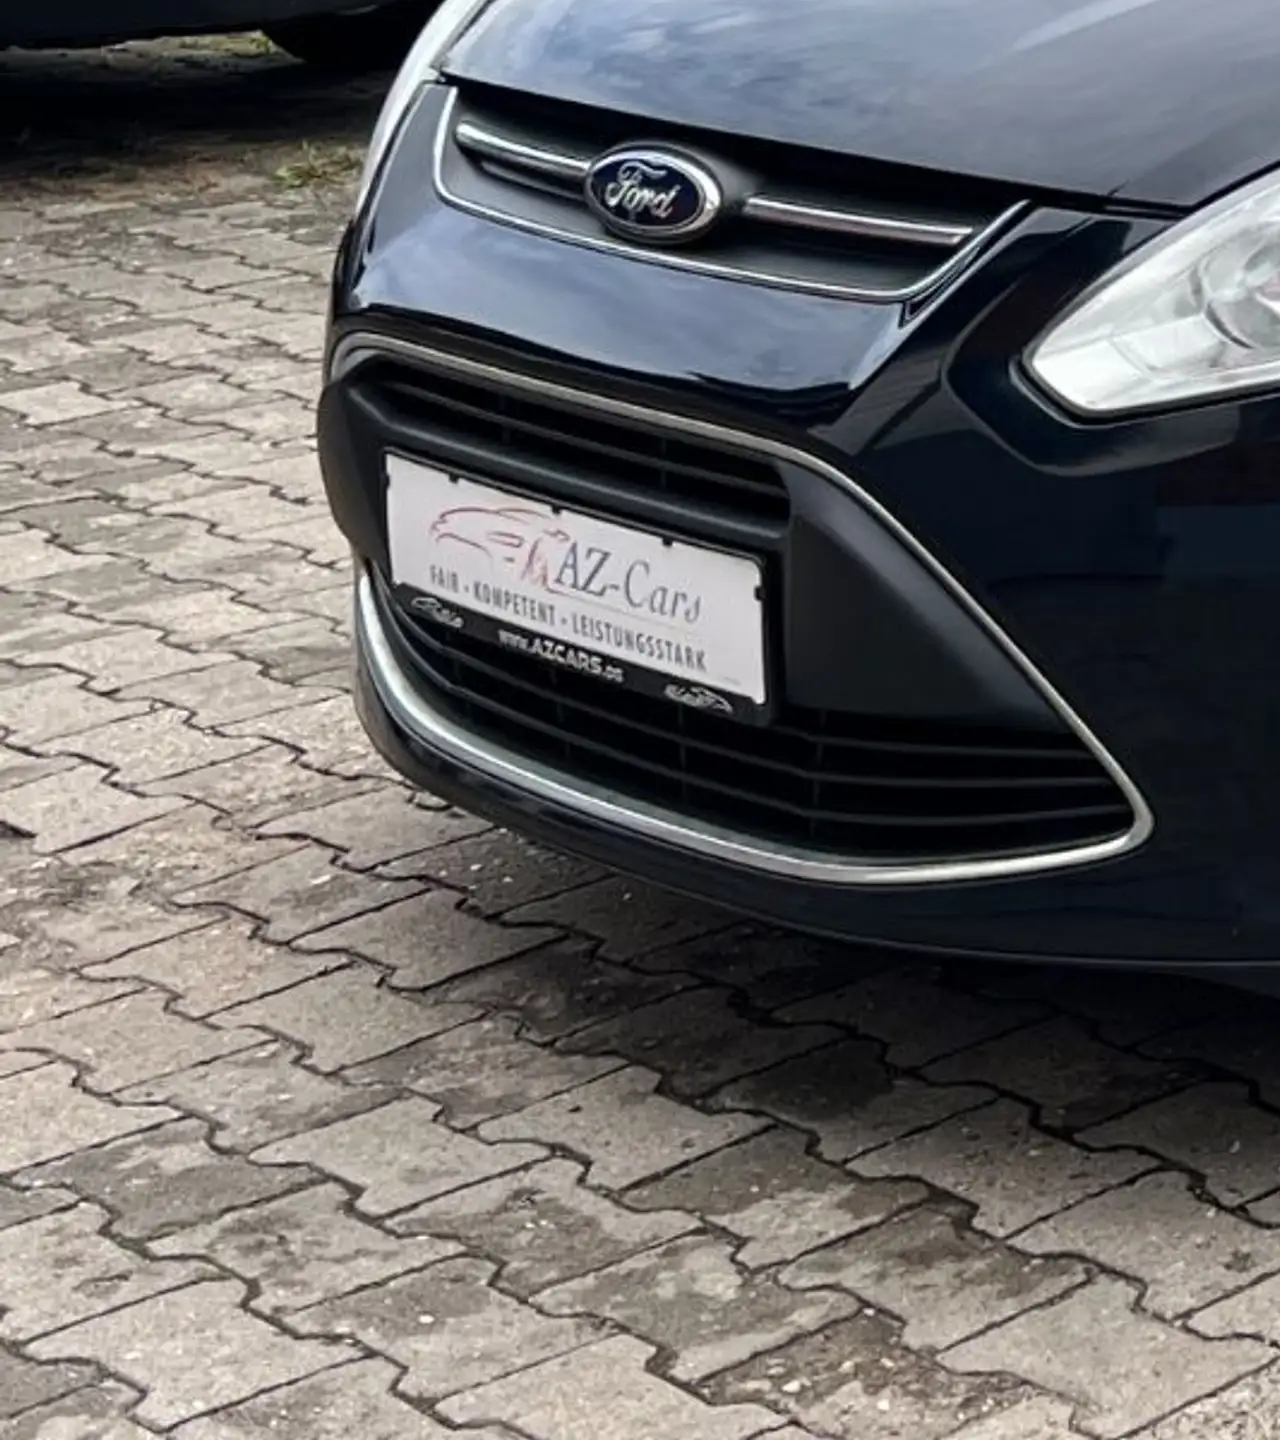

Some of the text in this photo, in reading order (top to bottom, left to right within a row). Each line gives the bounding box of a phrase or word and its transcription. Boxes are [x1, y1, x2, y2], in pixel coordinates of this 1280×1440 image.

[604, 160, 682, 219] Ford
[430, 563, 708, 672] FAIR KOMPETENT LEISTUNGSSTARK
[554, 540, 702, 624] AZ-Cars
